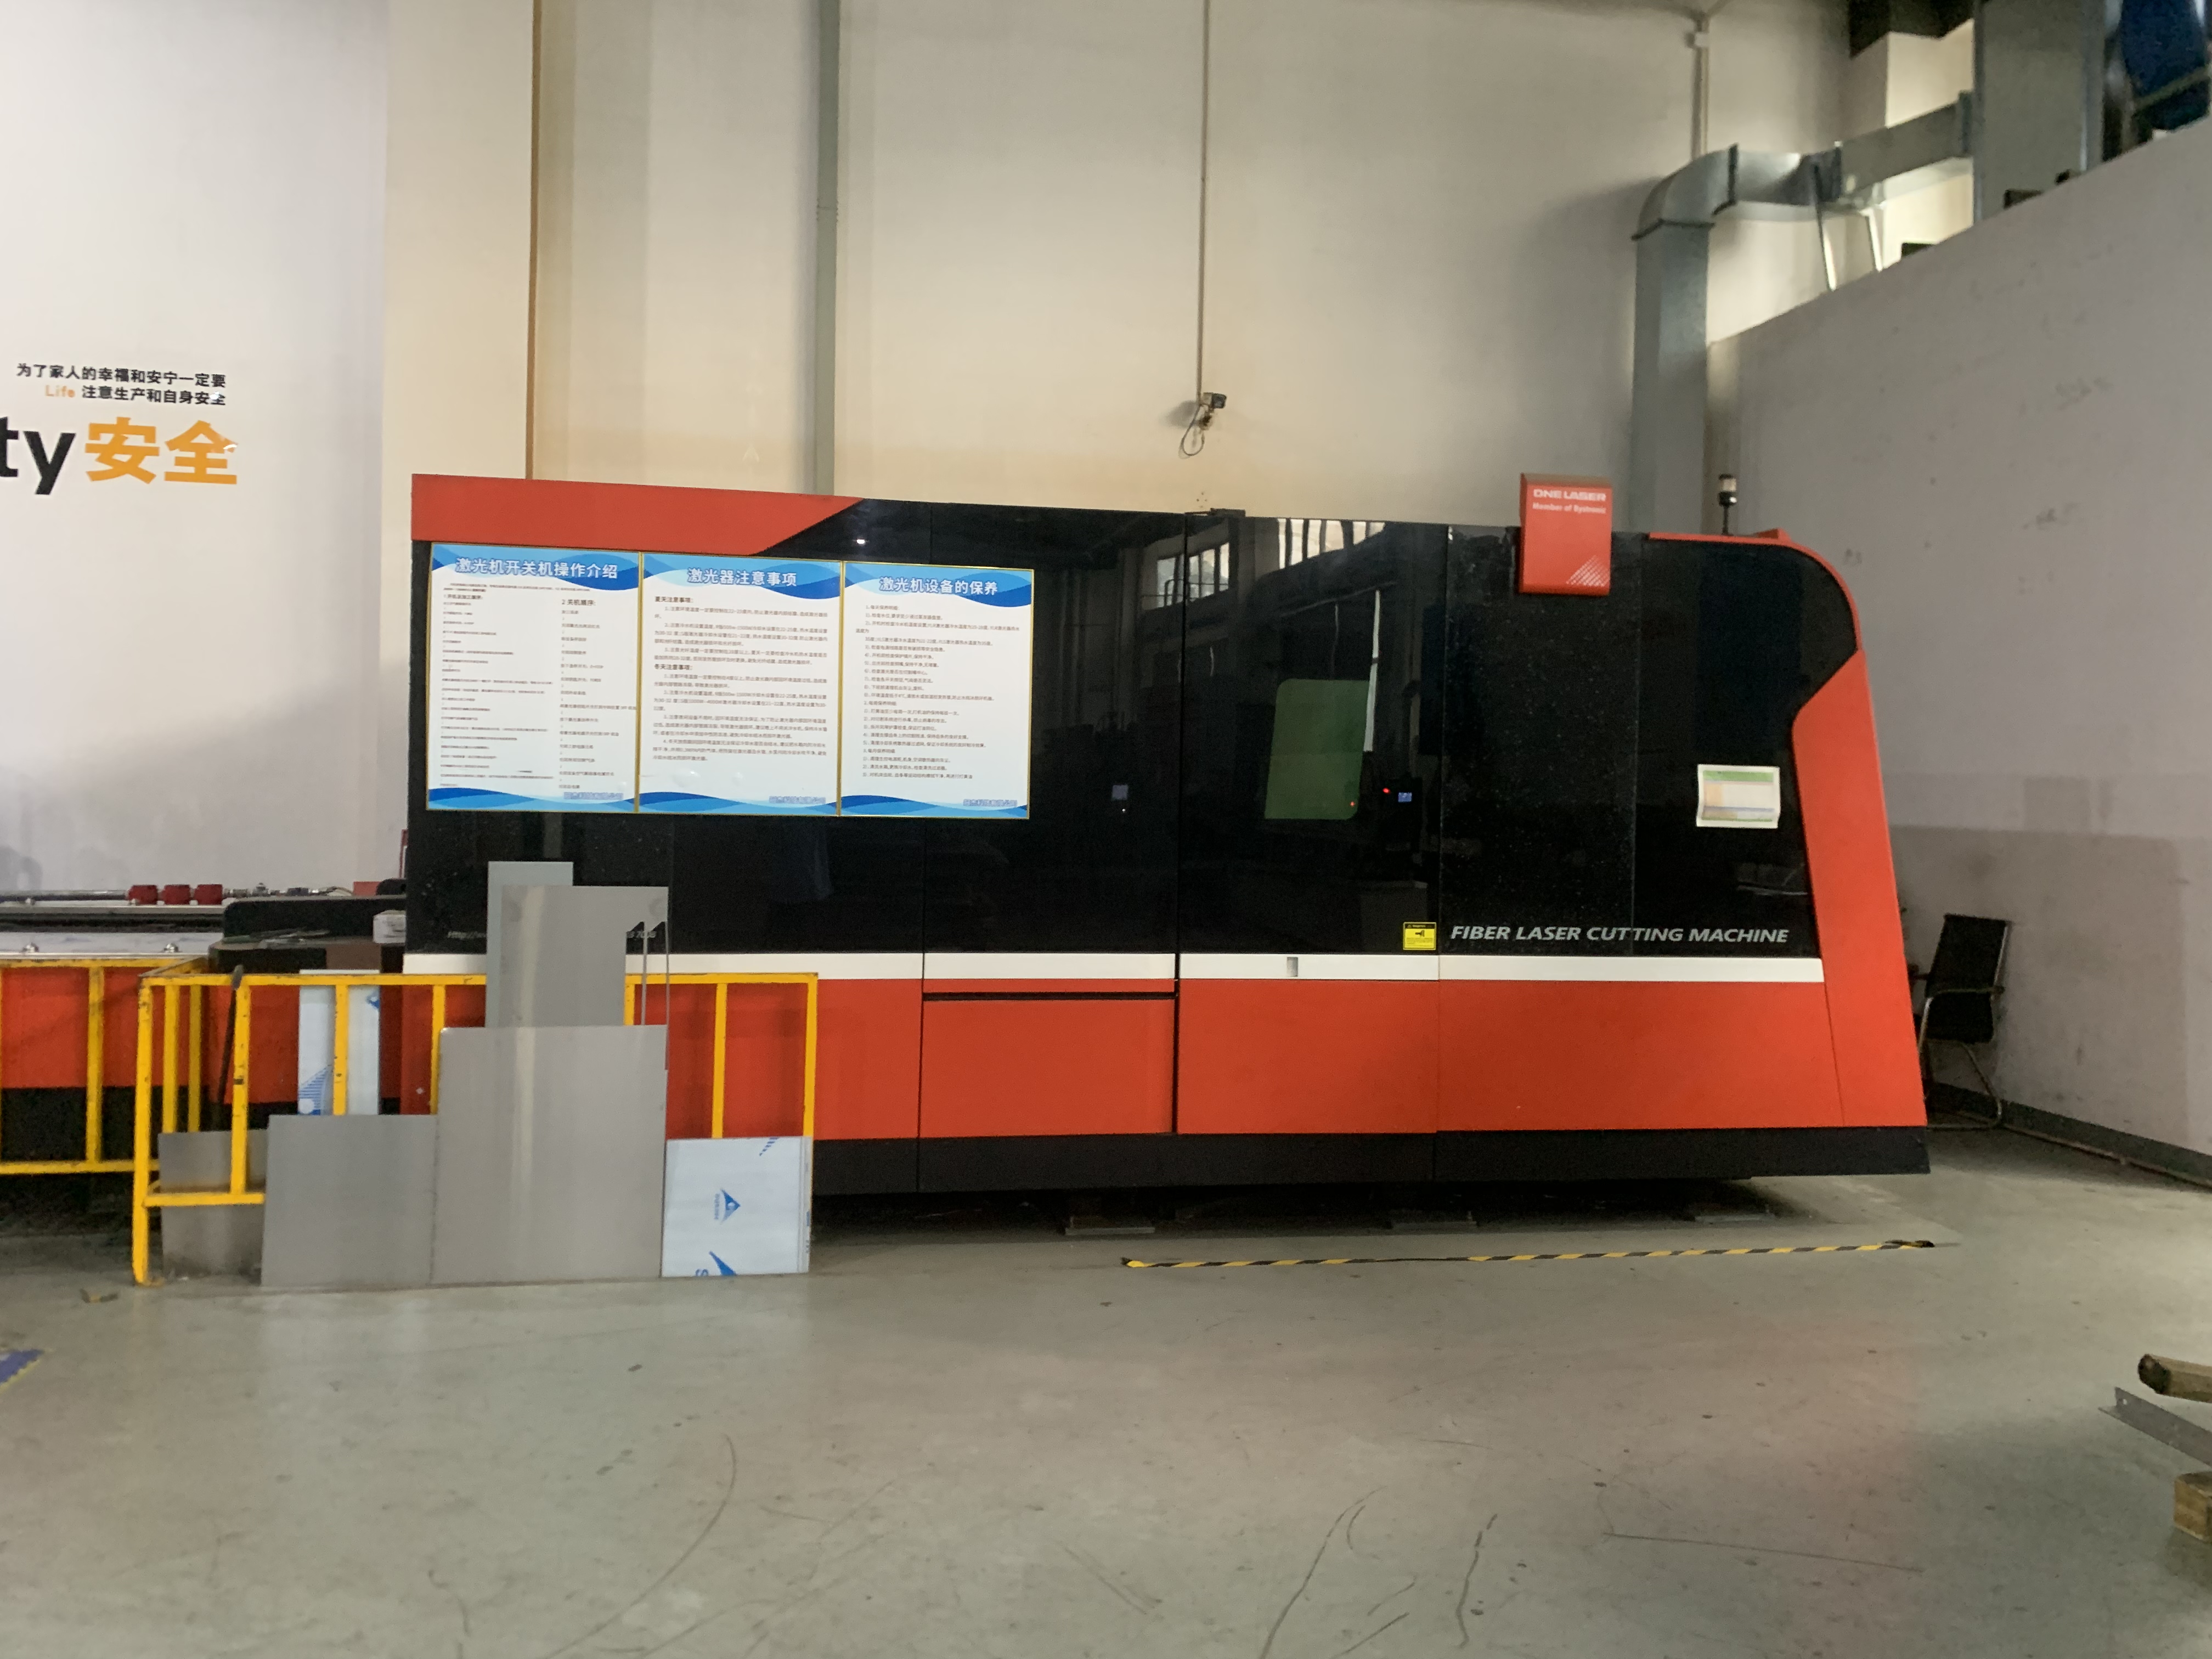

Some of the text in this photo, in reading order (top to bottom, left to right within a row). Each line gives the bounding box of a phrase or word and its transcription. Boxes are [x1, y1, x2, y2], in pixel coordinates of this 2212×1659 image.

[16, 363, 226, 388] 为了家人的幸福和安宁一定要
[45, 385, 76, 398] Life
[84, 416, 238, 485] 安全
[1564, 490, 1606, 501] LASER
[455, 556, 618, 579] 激光机开关机操作介绍
[687, 567, 798, 586] 激光器注意事项
[879, 575, 998, 596] 激光机设备的保养
[1451, 926, 1790, 943] FIBER LASER CUTTING MACHINE
